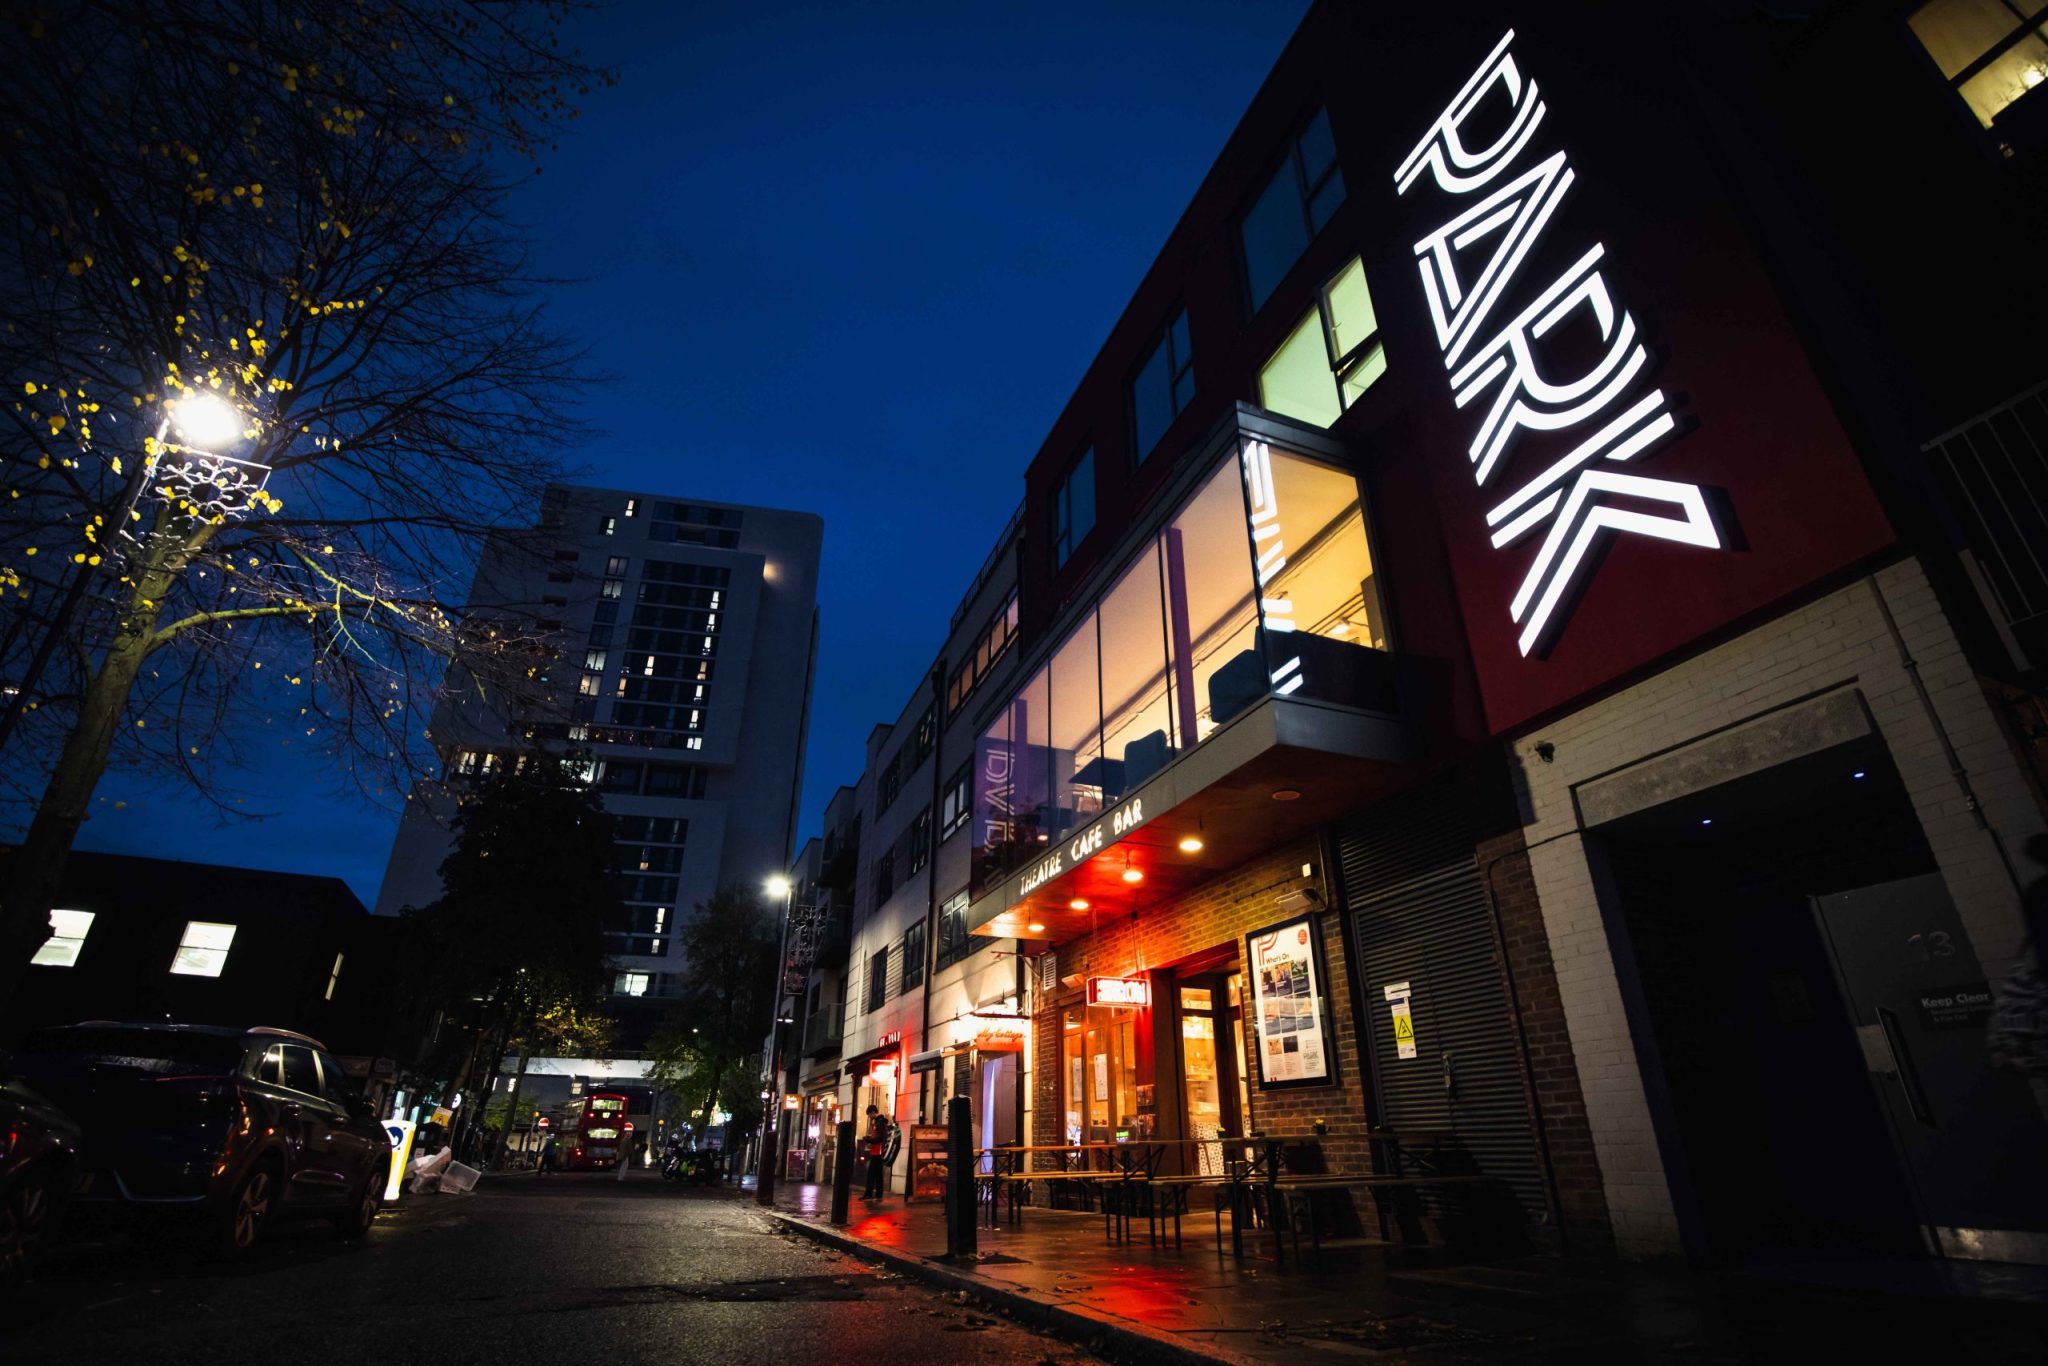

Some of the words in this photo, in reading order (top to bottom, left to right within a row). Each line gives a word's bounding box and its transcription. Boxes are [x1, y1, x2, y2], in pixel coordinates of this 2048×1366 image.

[1393, 27, 1721, 659] PARK
[1020, 852, 1062, 896] THEATRE
[1070, 824, 1103, 861] CAFE
[1113, 798, 1143, 836] BAR
[1921, 996, 1953, 1009] Keep
[1955, 992, 1990, 1004] Clear
